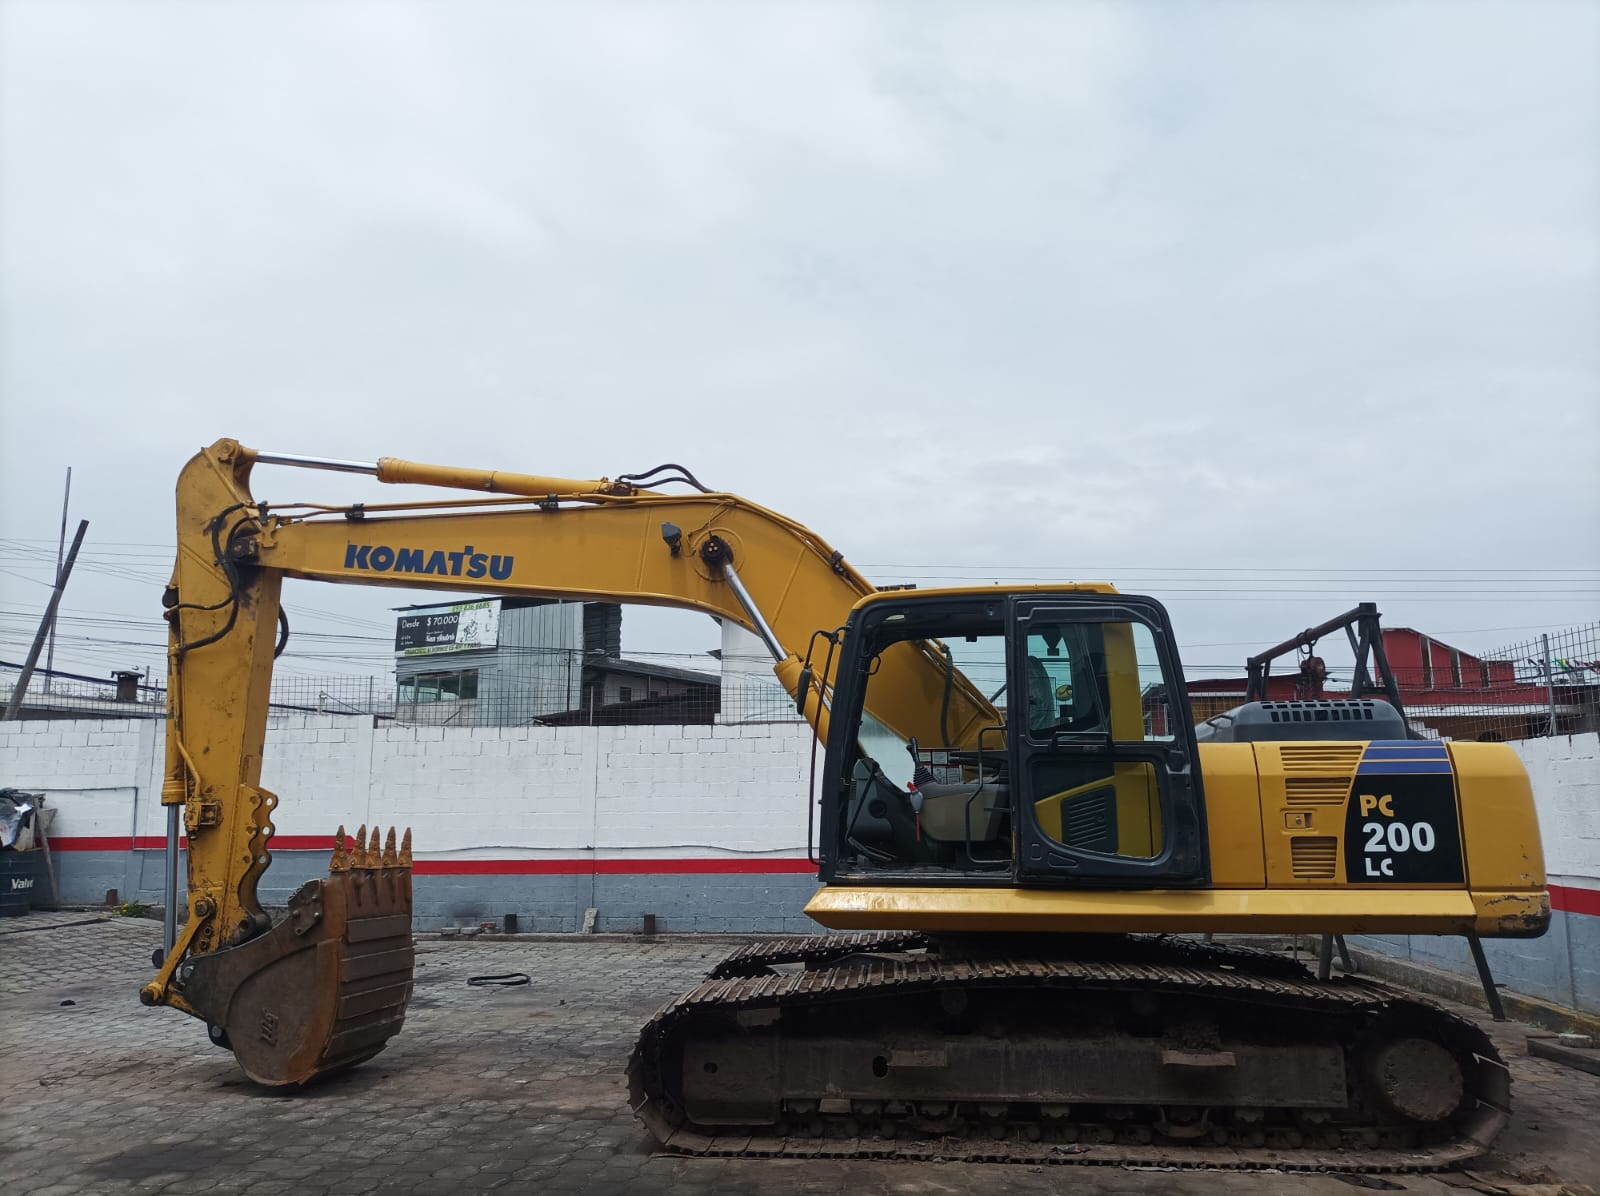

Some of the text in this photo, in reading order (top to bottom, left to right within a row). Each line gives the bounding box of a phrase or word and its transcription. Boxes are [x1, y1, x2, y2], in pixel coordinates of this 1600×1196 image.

[344, 544, 514, 581] KOMATSU
[401, 618, 420, 630] Desde
[1359, 794, 1395, 817] PC
[1362, 822, 1435, 852] 200
[1365, 857, 1394, 877] LC
